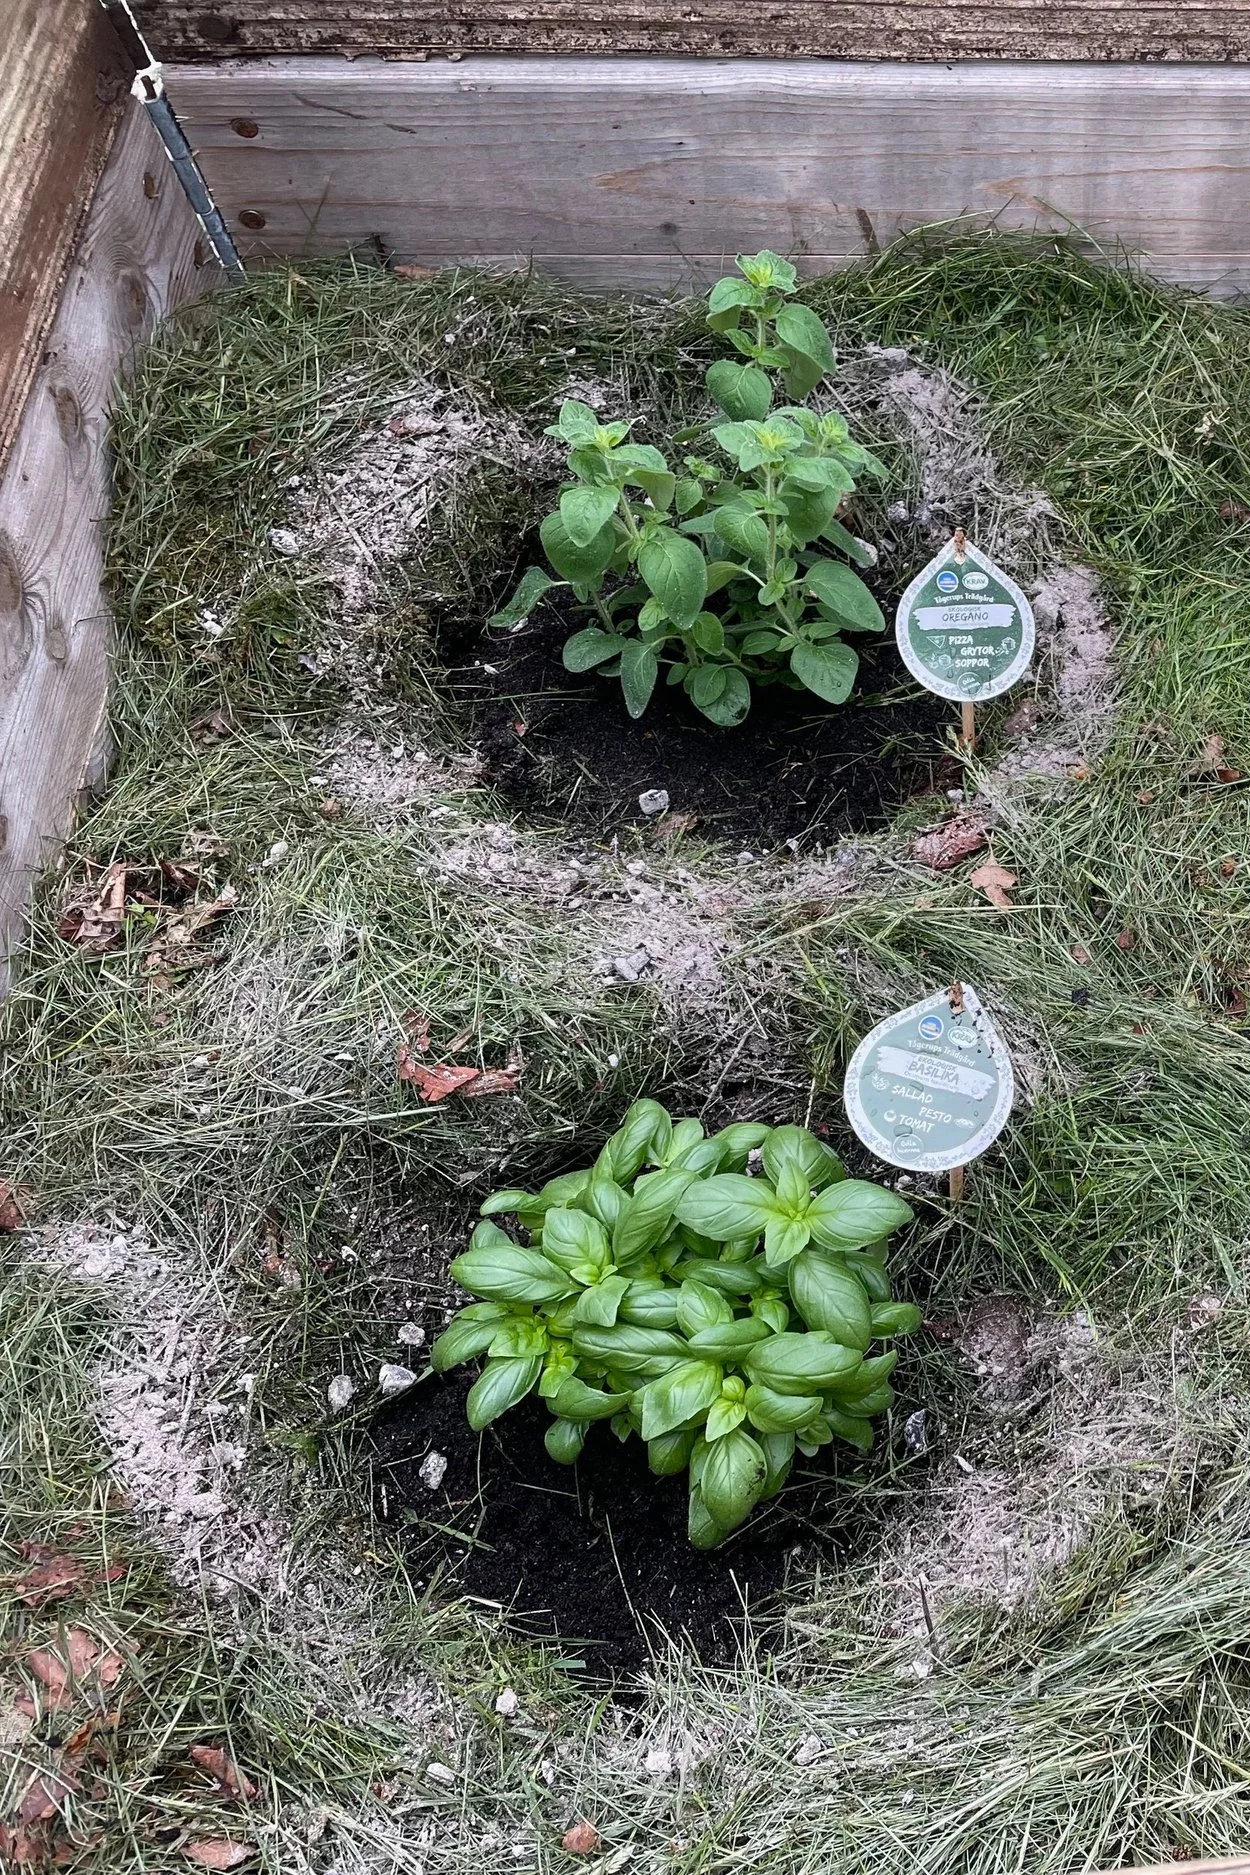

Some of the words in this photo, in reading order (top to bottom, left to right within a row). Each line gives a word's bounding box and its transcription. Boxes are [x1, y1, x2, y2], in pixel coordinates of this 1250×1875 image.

[966, 576, 986, 586] KRAV
[942, 613, 989, 622] OREGANO
[949, 635, 974, 645] PIZZA
[960, 646, 995, 656] GRYTOR
[955, 658, 990, 668] SOPPOR
[908, 1060, 961, 1086] BASILIKA
[891, 1084, 934, 1104] SALLAD
[918, 1107, 952, 1123] PESTO
[899, 1114, 936, 1133] TOMAT
